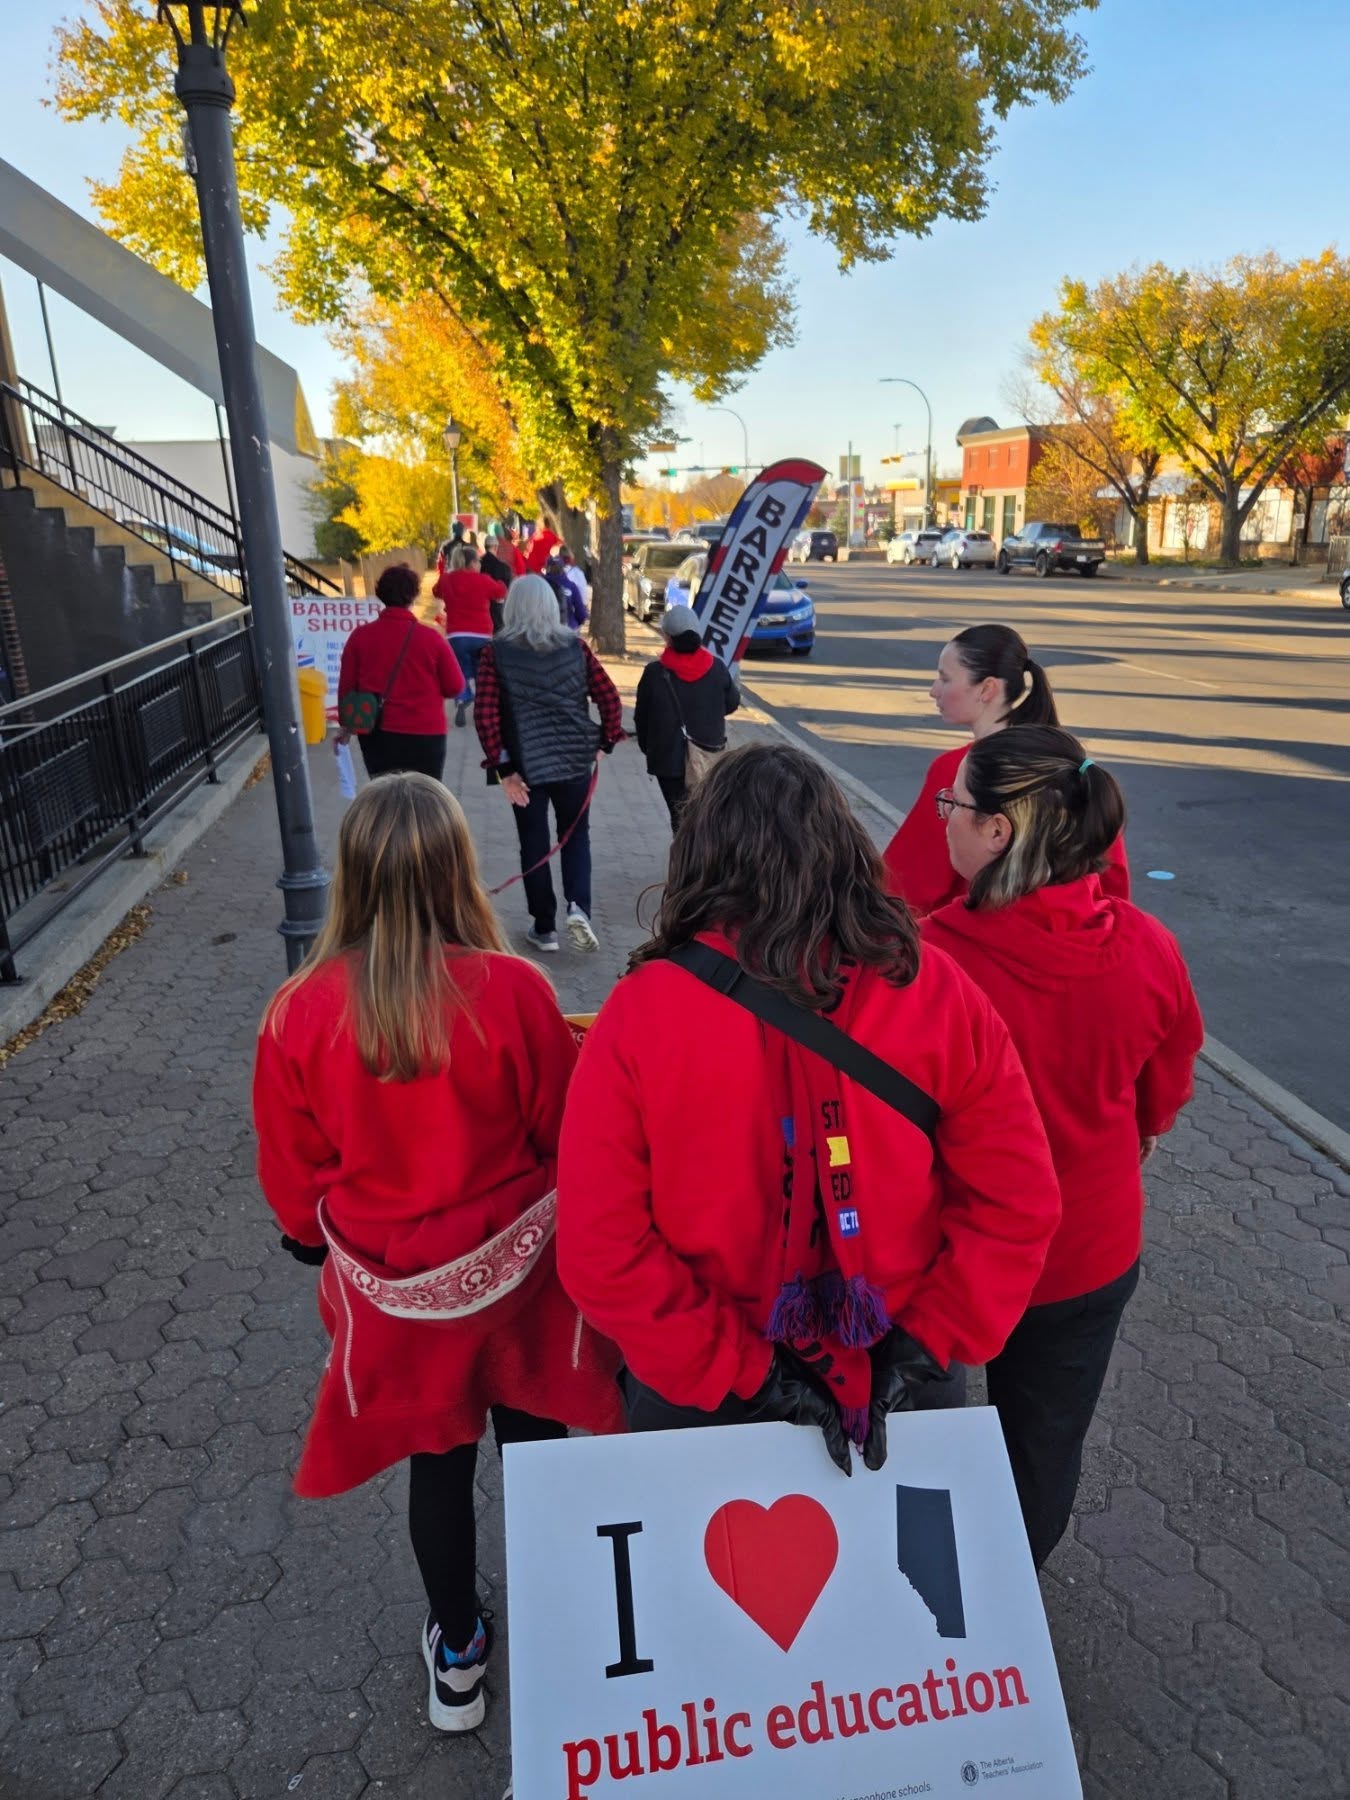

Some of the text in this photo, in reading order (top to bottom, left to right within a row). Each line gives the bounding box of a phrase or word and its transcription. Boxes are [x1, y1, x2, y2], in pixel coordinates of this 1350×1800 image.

[293, 603, 380, 616] BARBER
[703, 495, 785, 657] BARBER
[596, 1521, 654, 1679] I
[562, 1659, 1030, 1800] public education
[980, 1757, 1015, 1769] The Alberta
[1011, 1761, 1044, 1774] Association
